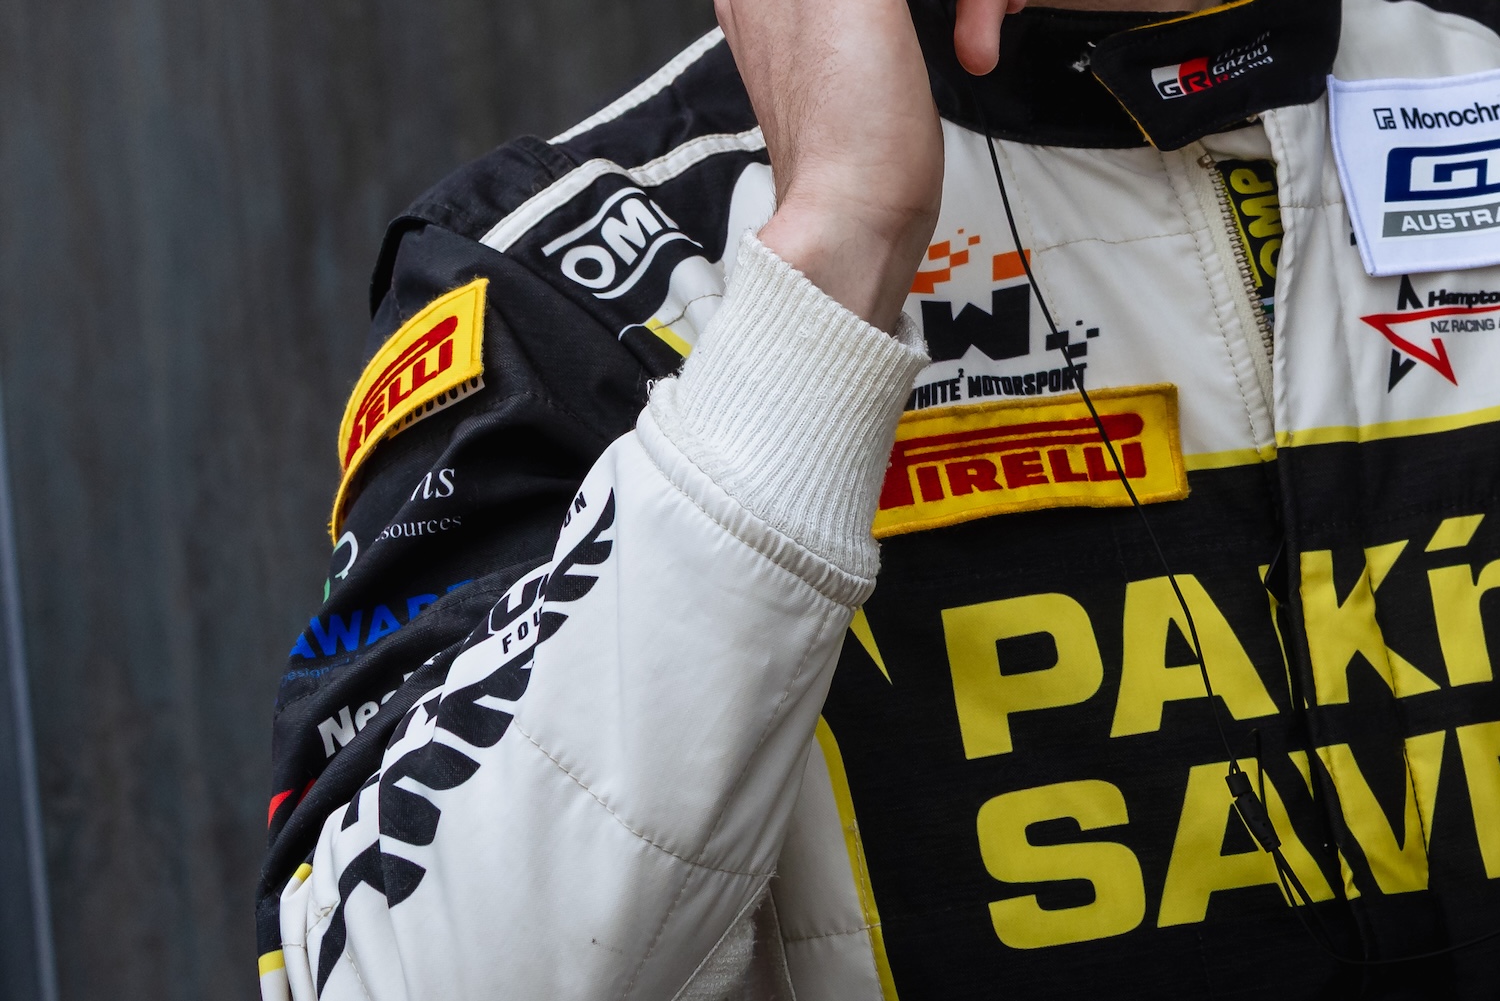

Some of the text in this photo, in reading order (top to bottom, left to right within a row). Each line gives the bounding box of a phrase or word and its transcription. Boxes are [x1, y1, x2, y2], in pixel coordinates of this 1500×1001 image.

[1212, 44, 1269, 75] GAZOO
[1154, 64, 1213, 99] GR
[1430, 320, 1450, 334] NZ
[1451, 317, 1496, 333] RACING
[967, 363, 1087, 399] MOTORSPORT
